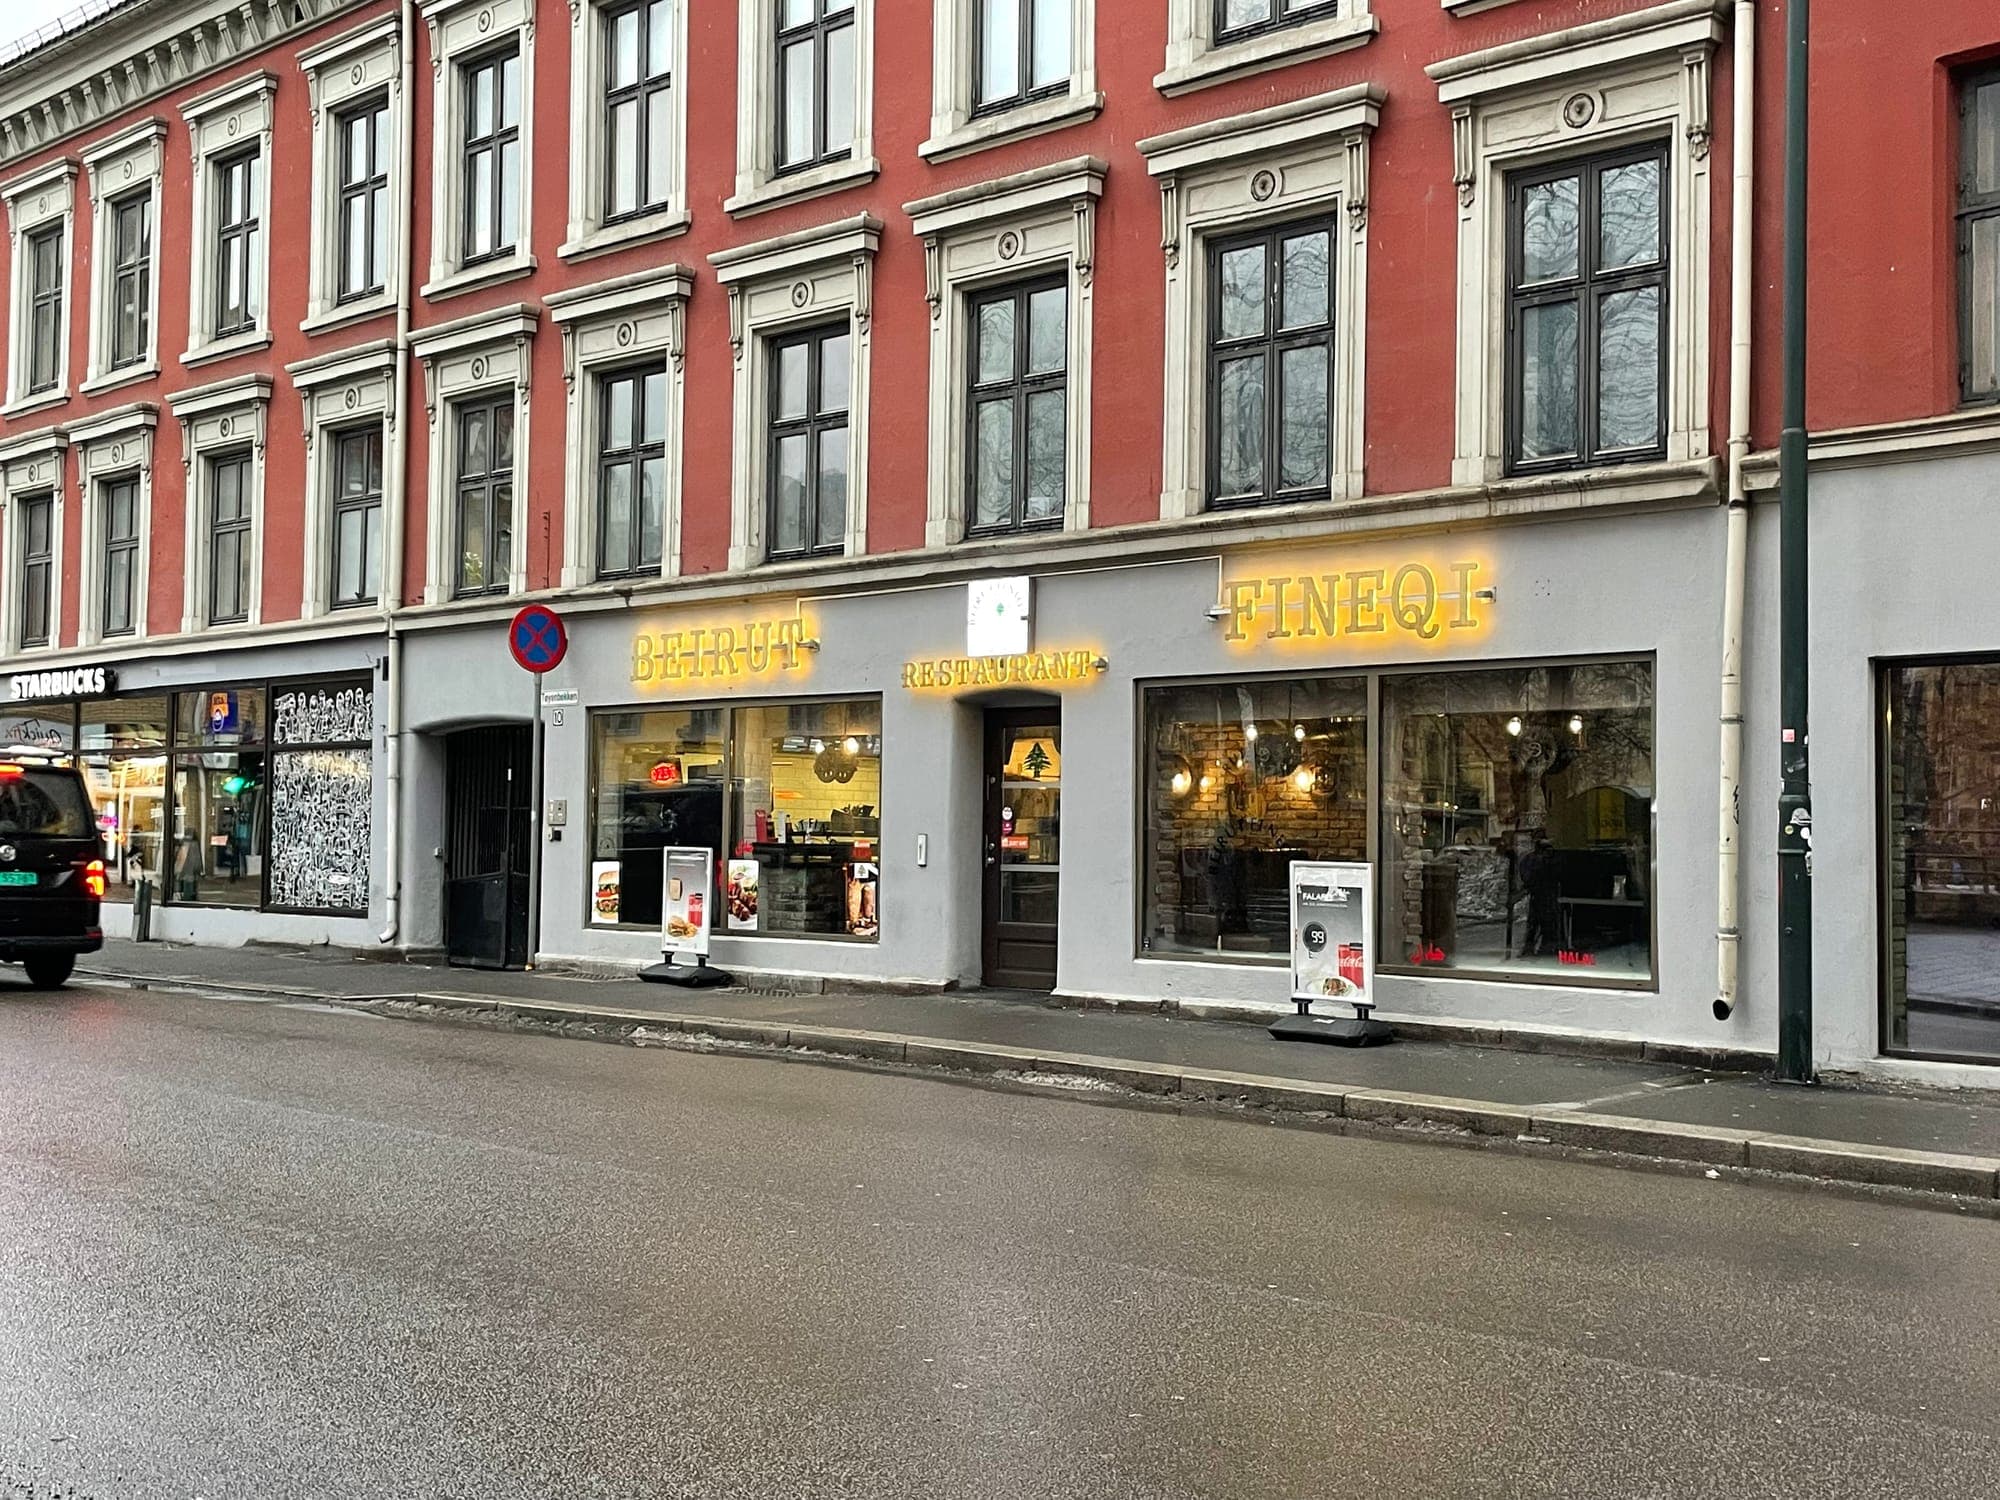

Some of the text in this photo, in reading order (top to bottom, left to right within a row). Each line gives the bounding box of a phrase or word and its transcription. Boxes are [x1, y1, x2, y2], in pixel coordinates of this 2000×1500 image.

[1224, 563, 1478, 640] FINEQI
[630, 619, 803, 682] BEIRUT
[901, 650, 1091, 689] RESTAURANT
[10, 667, 106, 699] STARBUCKS
